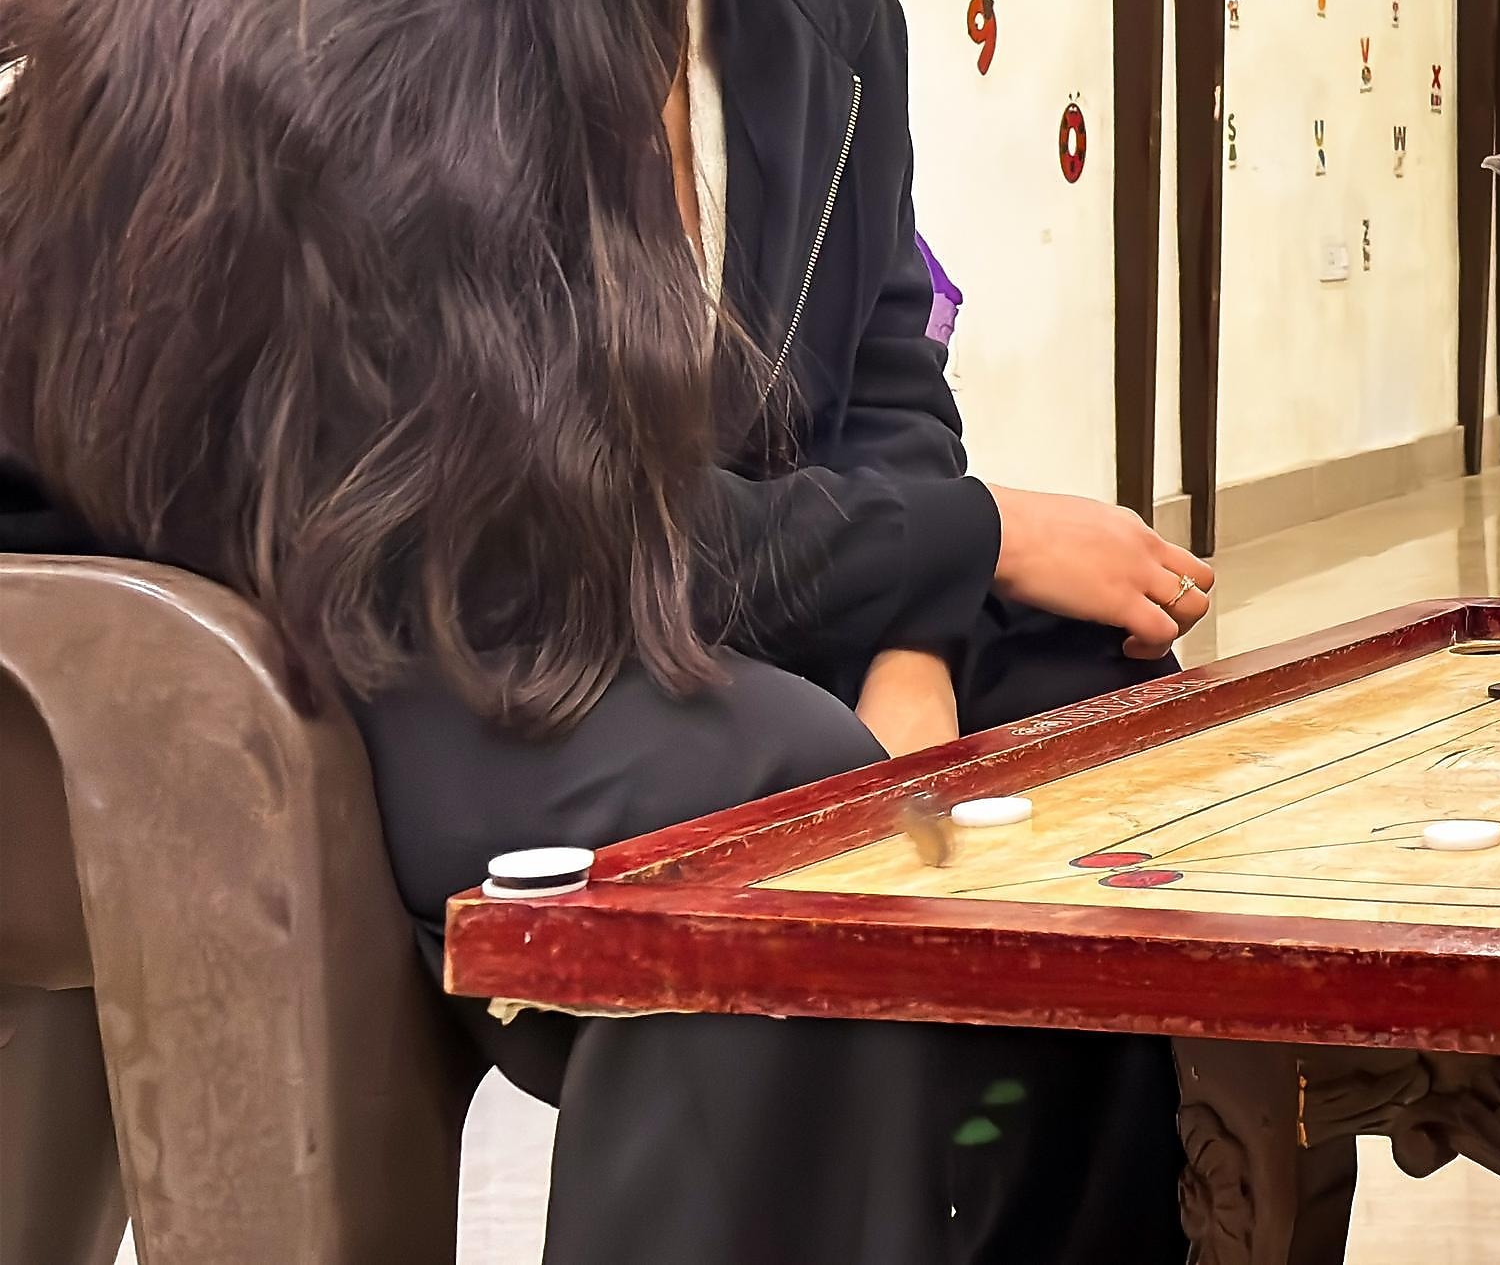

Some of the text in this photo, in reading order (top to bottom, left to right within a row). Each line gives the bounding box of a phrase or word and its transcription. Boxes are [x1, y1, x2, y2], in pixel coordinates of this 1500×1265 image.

[1360, 37, 1370, 63] V
[1432, 64, 1442, 90] X
[1228, 113, 1237, 142] S
[1314, 120, 1325, 147] U
[1393, 126, 1407, 151] W
